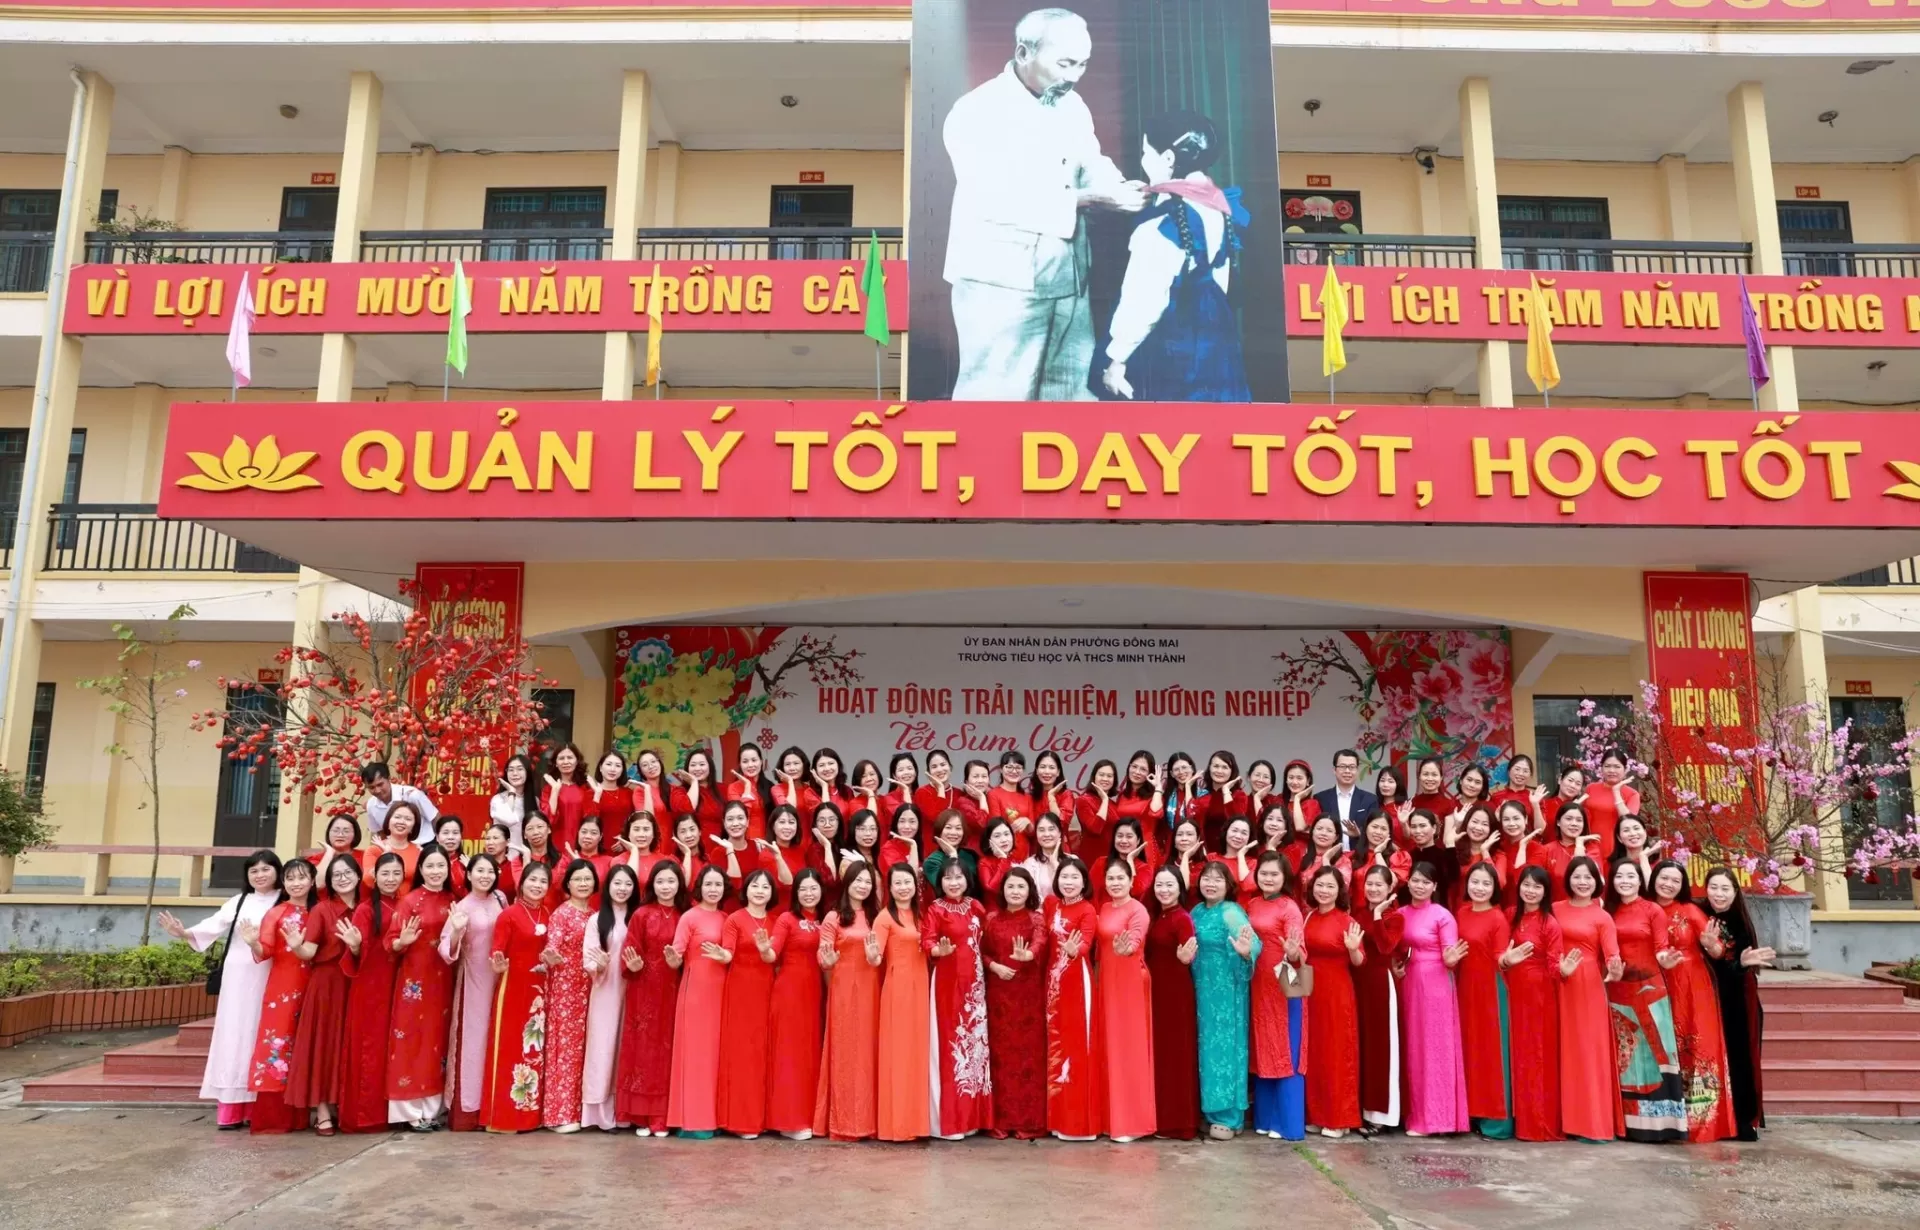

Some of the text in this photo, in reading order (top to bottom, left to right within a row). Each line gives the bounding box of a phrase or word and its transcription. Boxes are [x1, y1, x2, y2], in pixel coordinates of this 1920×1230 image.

[86, 268, 130, 316] VÌ
[153, 276, 224, 326] LỢI
[254, 266, 328, 316] ÍCH
[499, 267, 603, 314] NĂM
[629, 264, 773, 314] TRỒNG
[803, 265, 888, 313] CÂ
[1298, 281, 1365, 322] LI
[1390, 272, 1460, 323] ÍCH
[1481, 278, 1604, 326] TRĂM
[1621, 280, 1721, 329] NĂM
[1747, 278, 1885, 332] TRỒNG
[340, 405, 1863, 515] QUẢN LÝ TỐT, DẠY TỐT, HỌC TỐT
[963, 636, 1180, 649] ỦY BAN NHÂN DÂN PHƯỜNG ĐÔNG MAI
[1654, 596, 1747, 658] CHẤT LƯỢNG
[958, 651, 1186, 665] TRƯỜNG TIỂU HỌC VÀ THCS MINH THÀNH
[818, 682, 1311, 721] HOẠT ĐỘNG TRẢI NGHIỆM, HƯỚNG NGHIỆP
[1670, 671, 1741, 736] HIỆU QUẢ
[889, 721, 1095, 763] Tết Sum Vầy
